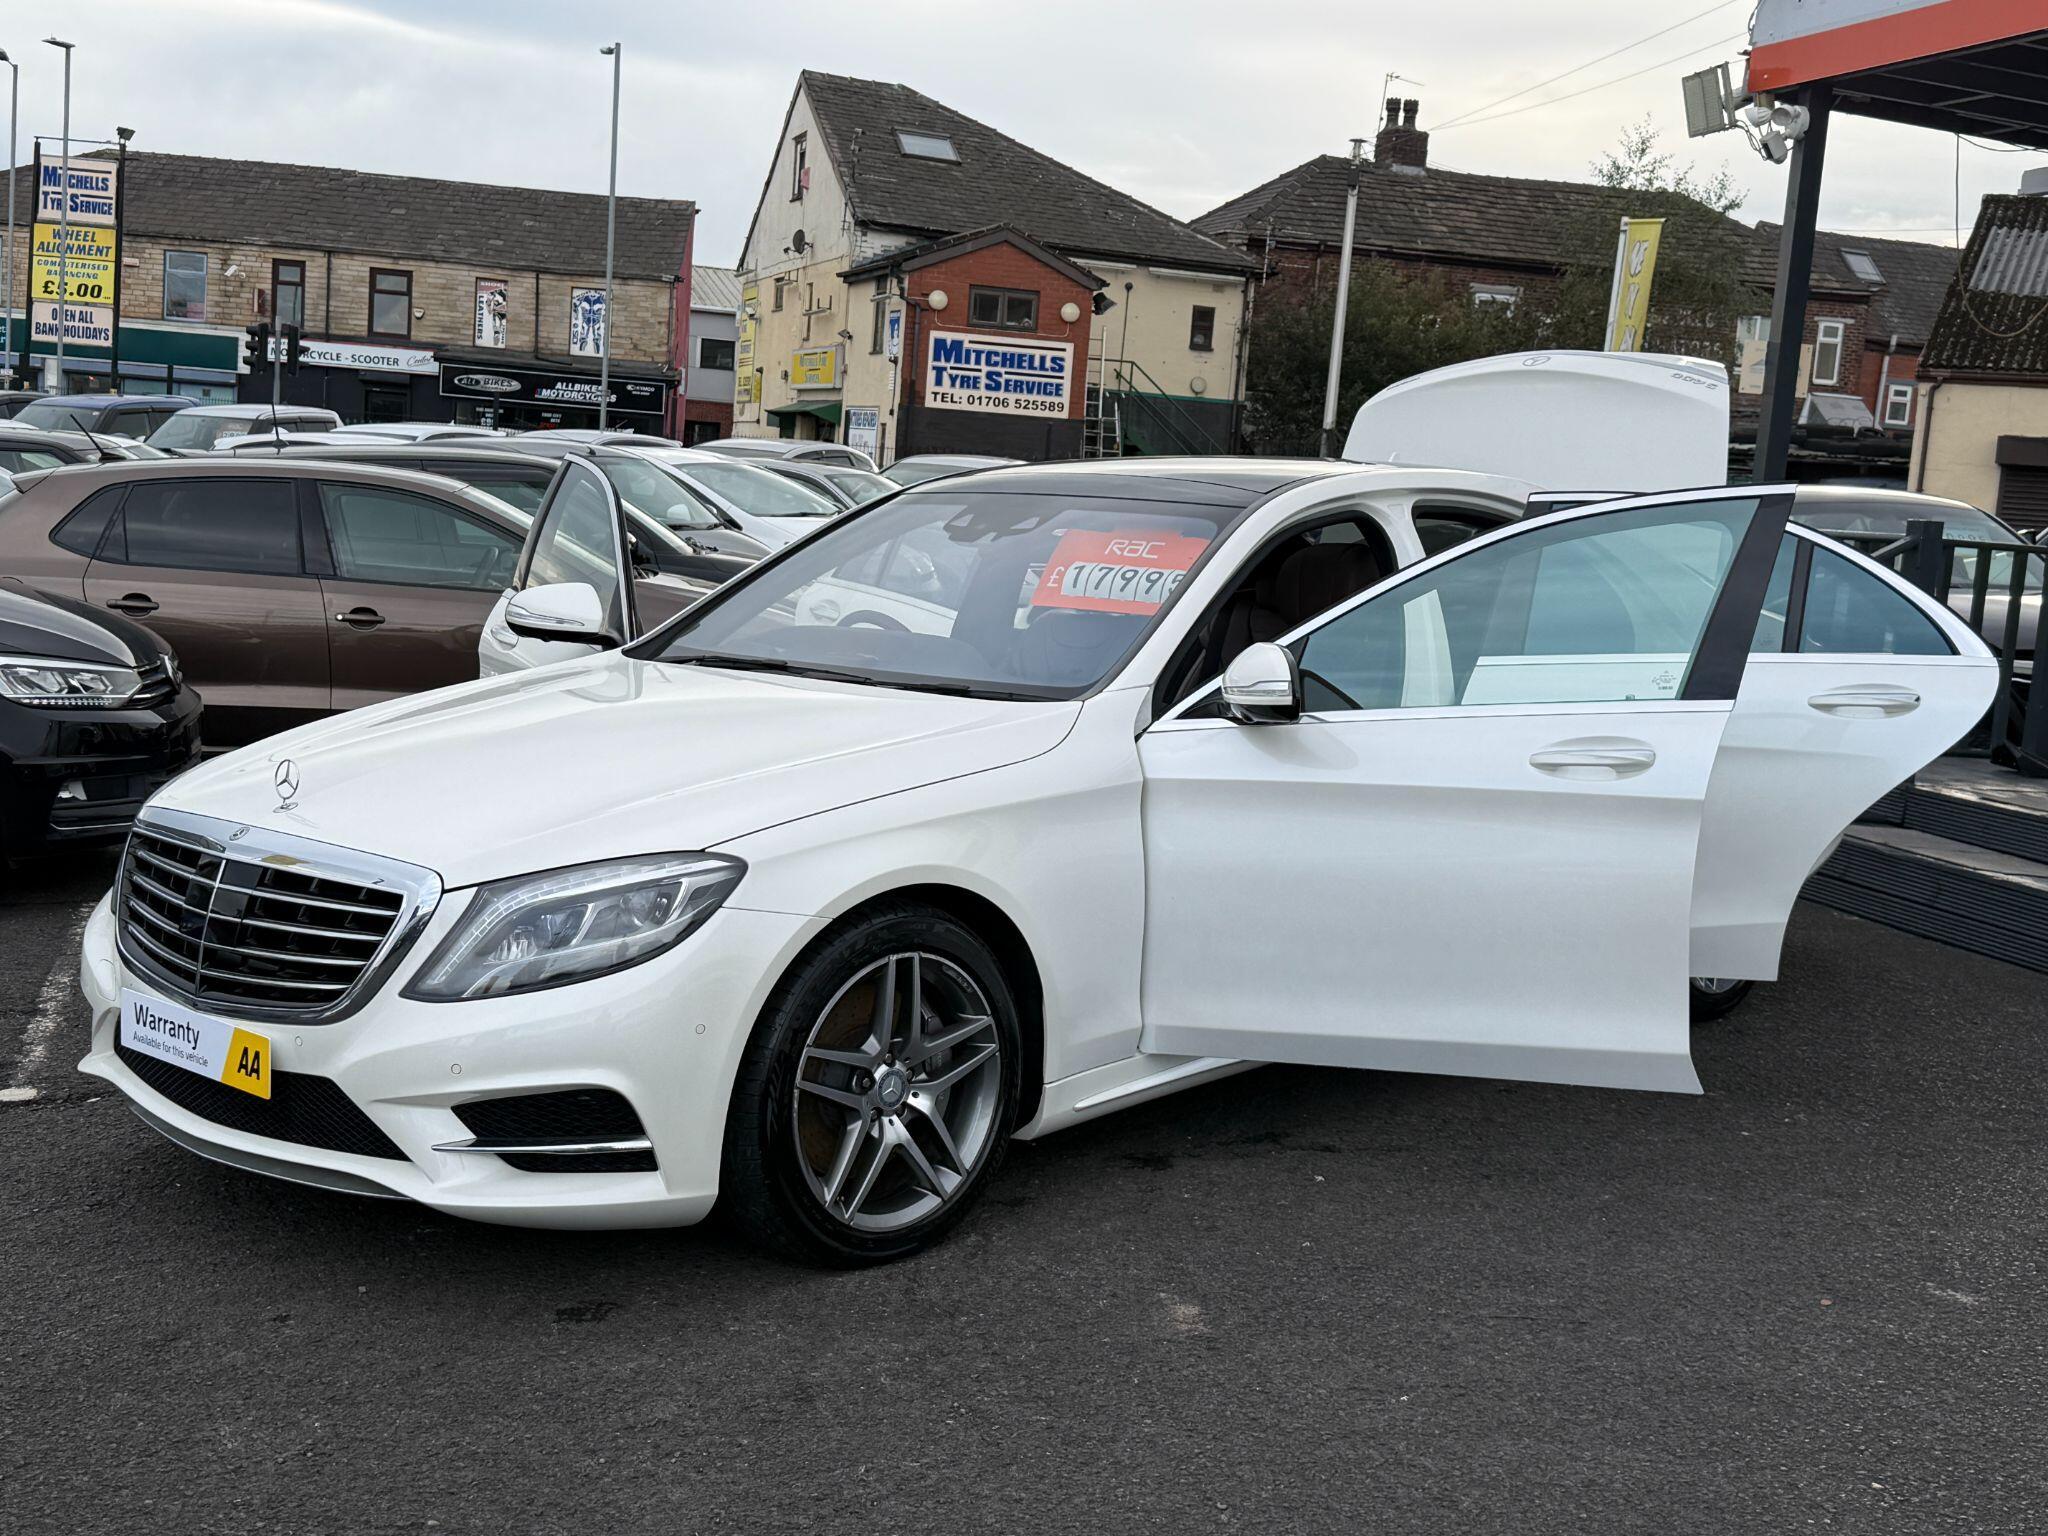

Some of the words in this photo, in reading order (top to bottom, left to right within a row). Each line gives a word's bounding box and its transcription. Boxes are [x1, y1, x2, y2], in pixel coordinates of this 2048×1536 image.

[42, 165, 110, 191] MICHELLS
[69, 193, 113, 215] SERVICE
[51, 307, 76, 323] OEN
[78, 310, 94, 325] ALL
[477, 295, 485, 340] LEATHERS
[63, 324, 110, 341] HOLIDAYS
[350, 353, 399, 367] SCOOTER
[933, 338, 1066, 373] MITCHELLS
[484, 377, 513, 388] BIKES
[932, 365, 981, 390] TYRE
[985, 370, 1064, 397] SERVICE
[931, 391, 962, 404] TEL:
[967, 394, 1010, 408] 01706
[1014, 398, 1065, 413] 525589
[134, 1002, 200, 1051] Warranty
[133, 1031, 161, 1050] Available
[162, 1041, 171, 1053] for
[172, 1045, 184, 1059] this
[185, 1051, 209, 1067] vehicle
[237, 1046, 261, 1081] AA
